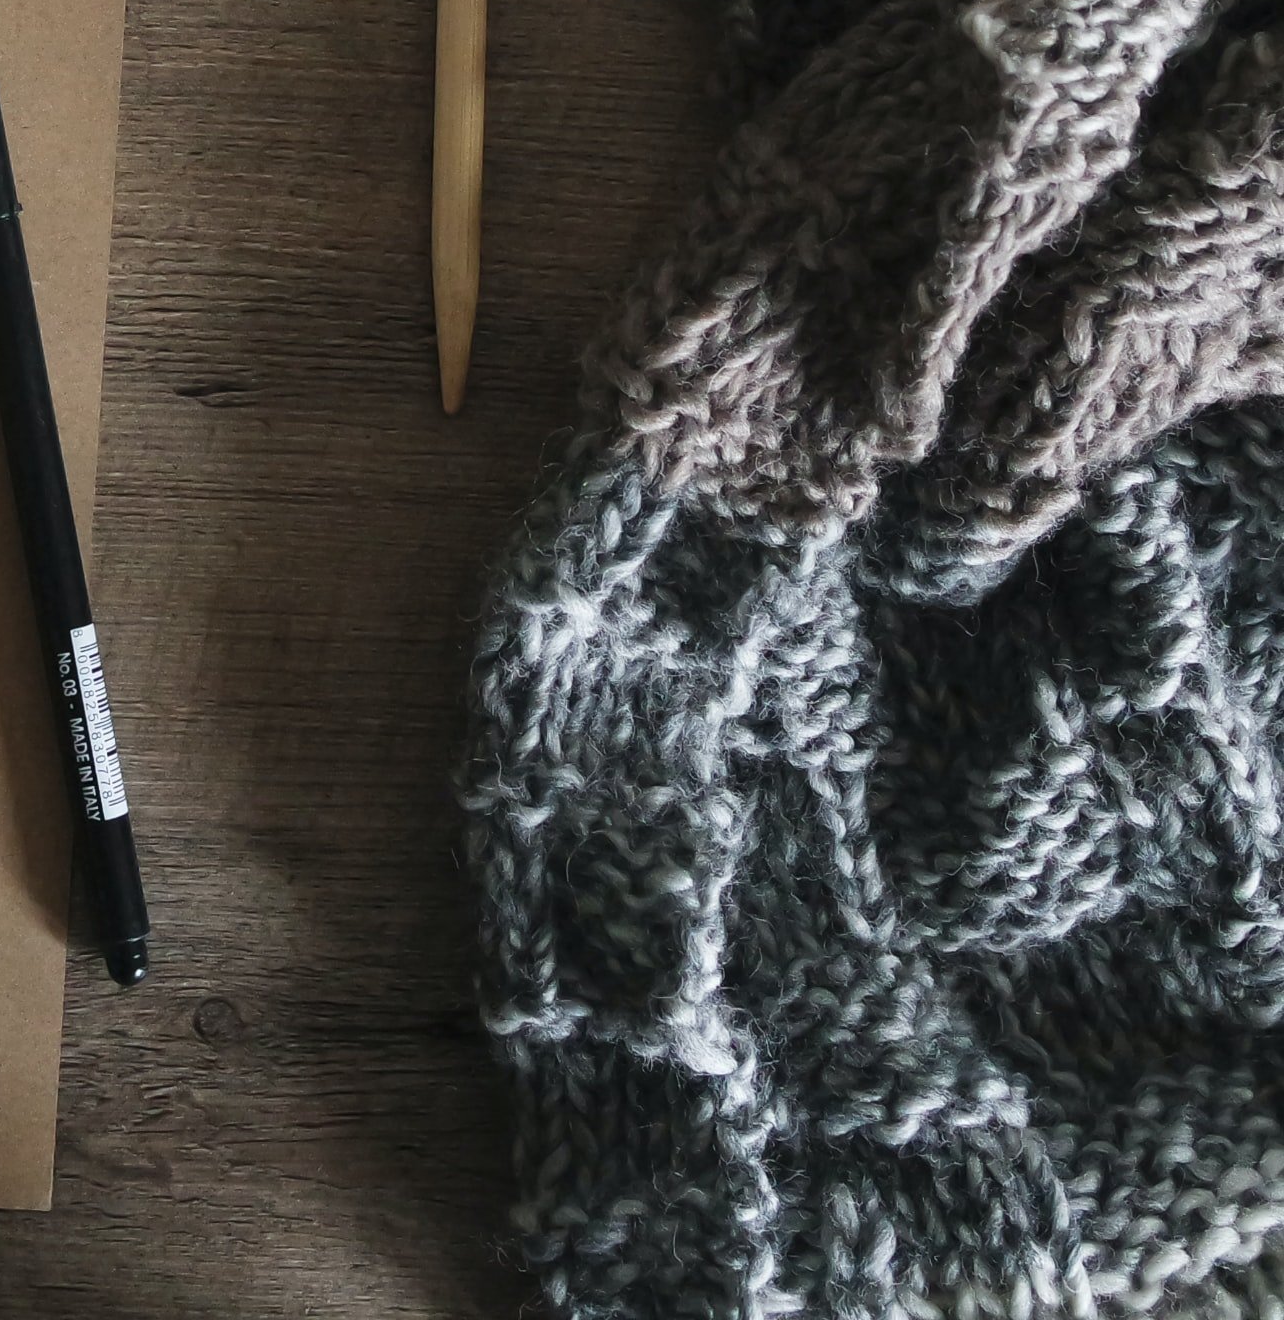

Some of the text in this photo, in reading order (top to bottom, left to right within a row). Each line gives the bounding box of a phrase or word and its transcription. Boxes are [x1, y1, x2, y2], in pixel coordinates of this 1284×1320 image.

[57, 652, 72, 678] No.
[62, 679, 78, 697] 03
[72, 629, 113, 799] 8 000825 830778
[69, 717, 90, 763] MADE
[78, 765, 94, 783] IN
[82, 785, 101, 821] ITALY
